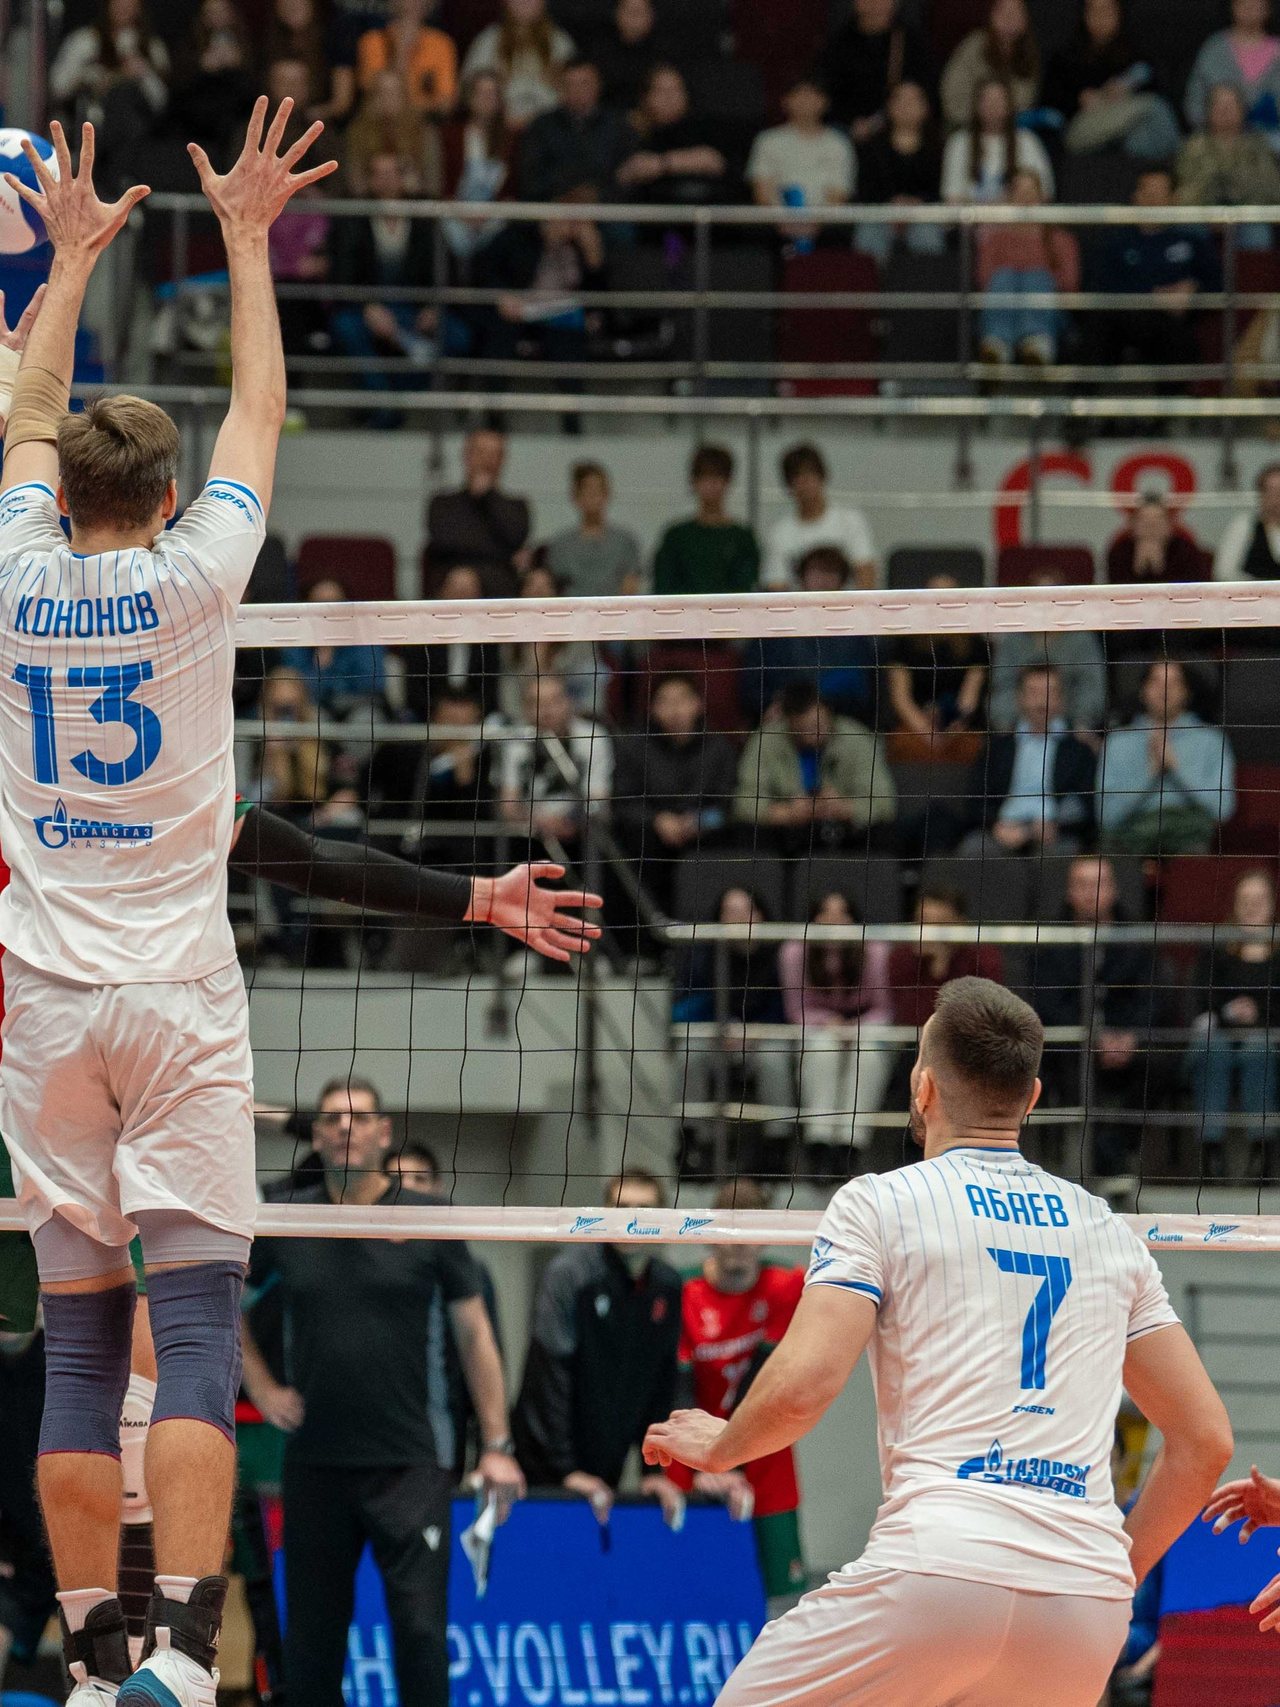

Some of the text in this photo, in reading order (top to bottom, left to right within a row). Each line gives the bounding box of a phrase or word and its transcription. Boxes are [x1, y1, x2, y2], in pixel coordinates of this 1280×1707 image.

[14, 590, 160, 638] КОНОНОВ
[10, 660, 162, 786] 13
[70, 840, 152, 849] КАЗАНЬ
[71, 827, 152, 837] ТРАНСГАЗ
[965, 1184, 1069, 1228] АБАЕВ
[986, 1247, 1073, 1390] 7
[1012, 1405, 1056, 1416] ENSEN
[1006, 1457, 1091, 1484] ГАЗПРОМ
[1019, 1477, 1084, 1497] АНСГАЗ
